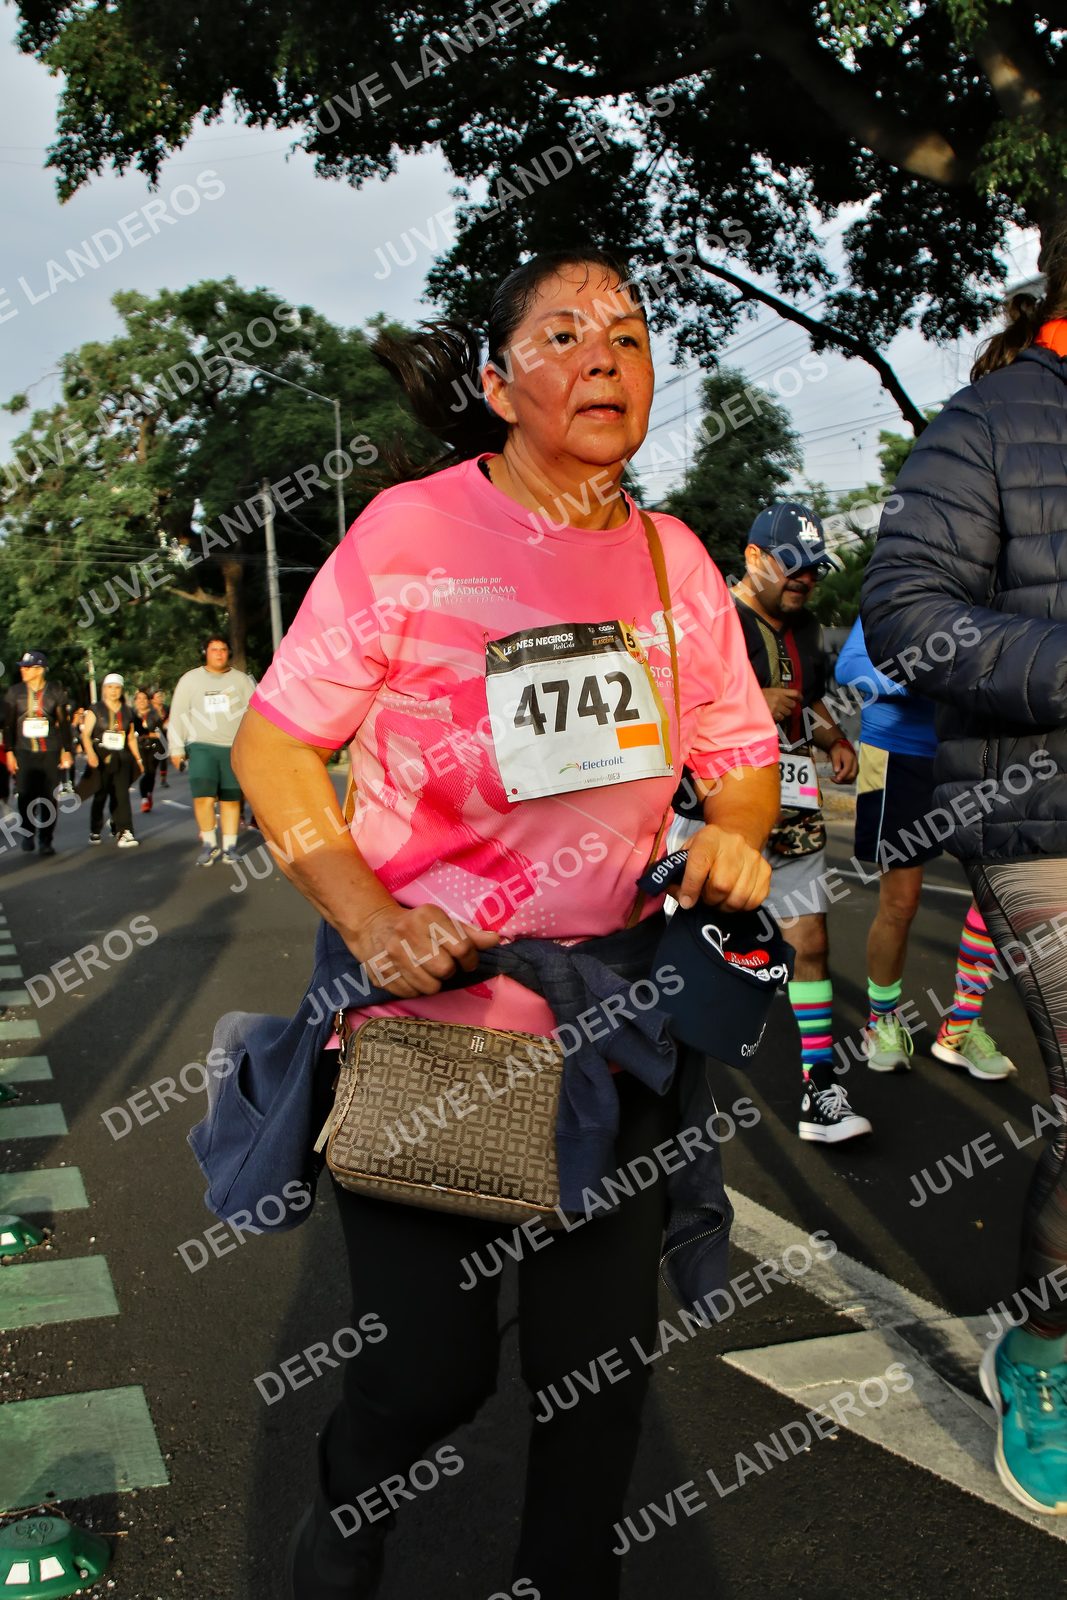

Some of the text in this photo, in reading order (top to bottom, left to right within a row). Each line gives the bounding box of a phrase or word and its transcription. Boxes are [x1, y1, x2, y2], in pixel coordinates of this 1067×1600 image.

[535, 632, 574, 646] NEGROS
[514, 671, 640, 736] 4742
[582, 755, 624, 770] Electrolit
[651, 850, 689, 884] HICAGO
